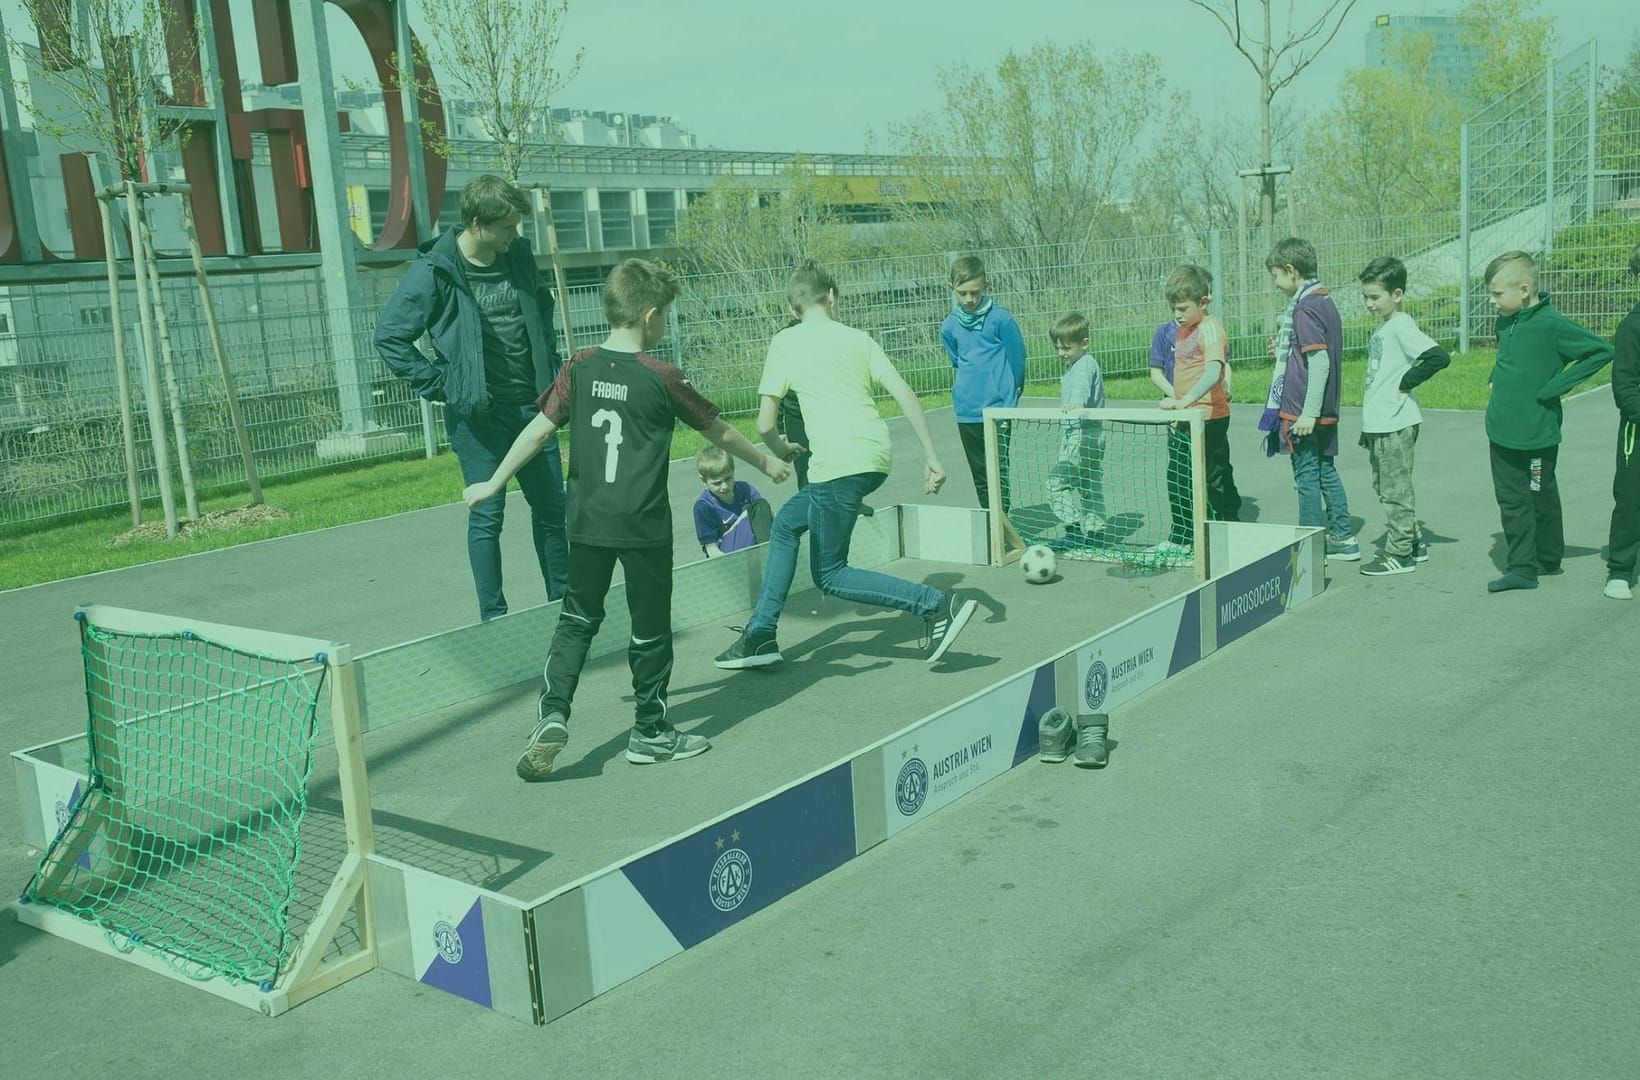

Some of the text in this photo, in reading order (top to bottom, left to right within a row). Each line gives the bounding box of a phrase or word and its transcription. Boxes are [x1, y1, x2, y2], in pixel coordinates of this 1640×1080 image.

[592, 381, 628, 401] FABIAN
[1221, 576, 1281, 627] MICROSOCCER
[1112, 656, 1137, 681] AUSTRIA
[1138, 646, 1154, 666] WIEN
[934, 747, 969, 780] AUSTRIA
[970, 734, 992, 759] WIEN
